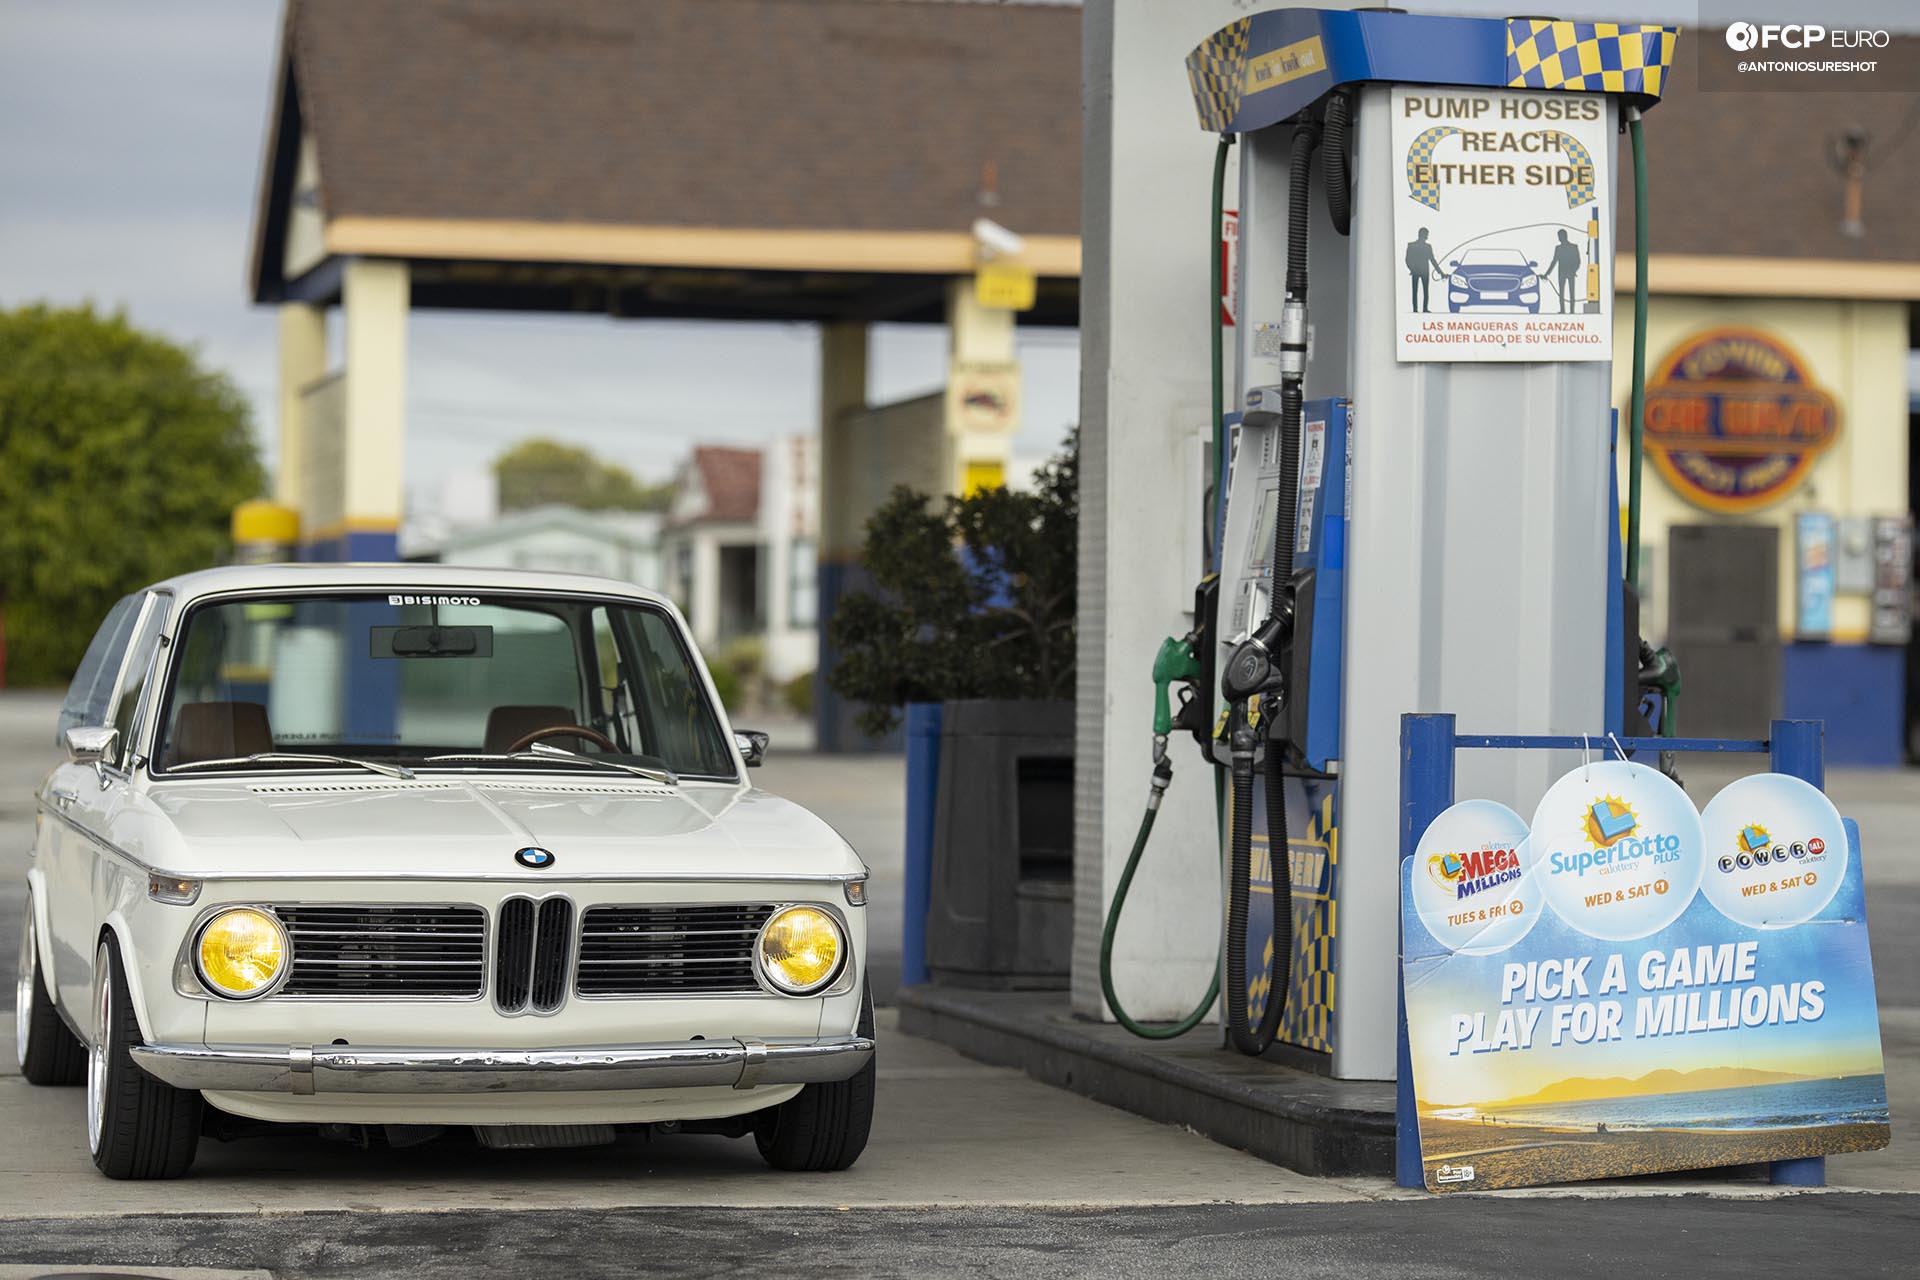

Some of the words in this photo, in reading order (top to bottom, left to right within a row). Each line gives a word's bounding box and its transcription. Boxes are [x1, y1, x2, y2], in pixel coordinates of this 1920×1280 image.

[1280, 53, 1299, 73] kwik
[1404, 97, 1490, 119] PUMP
[1501, 99, 1600, 121] HOSES
[1462, 131, 1561, 153] REACH
[1415, 164, 1515, 185] EITHER
[1525, 164, 1592, 186] SIDE
[1422, 321, 1444, 331] LAS
[1447, 321, 1519, 331] MANGUERAS
[1525, 321, 1585, 331] ALCANZAN
[1405, 333, 1470, 343] CUALQUIER
[1474, 334, 1504, 343] LADO
[1507, 334, 1522, 343] DE
[1525, 334, 1540, 343] SU
[1543, 334, 1602, 344] VEHICULO.
[404, 596, 481, 606] BISIMOTO
[1458, 848, 1520, 882] MEGA
[1550, 833, 1681, 876] SuperLotto
[1653, 850, 1681, 864] PLUS
[1457, 867, 1522, 900] MILLIONS
[1742, 883, 1767, 897] WED
[1769, 881, 1778, 892] &
[1780, 876, 1802, 890] SAT
[1584, 892, 1612, 908] WED
[1615, 890, 1625, 901] &
[1628, 883, 1651, 899] SAT
[1448, 911, 1476, 927] TUES
[1478, 910, 1486, 921] &
[1489, 904, 1507, 918] FRI
[1502, 956, 1592, 1004] PICK
[1600, 953, 1628, 997] A
[1637, 941, 1759, 992] GAME
[1449, 1007, 1542, 1055] PLAY
[1552, 1000, 1624, 1047] FOR
[1635, 980, 1826, 1040] MILLIONS
